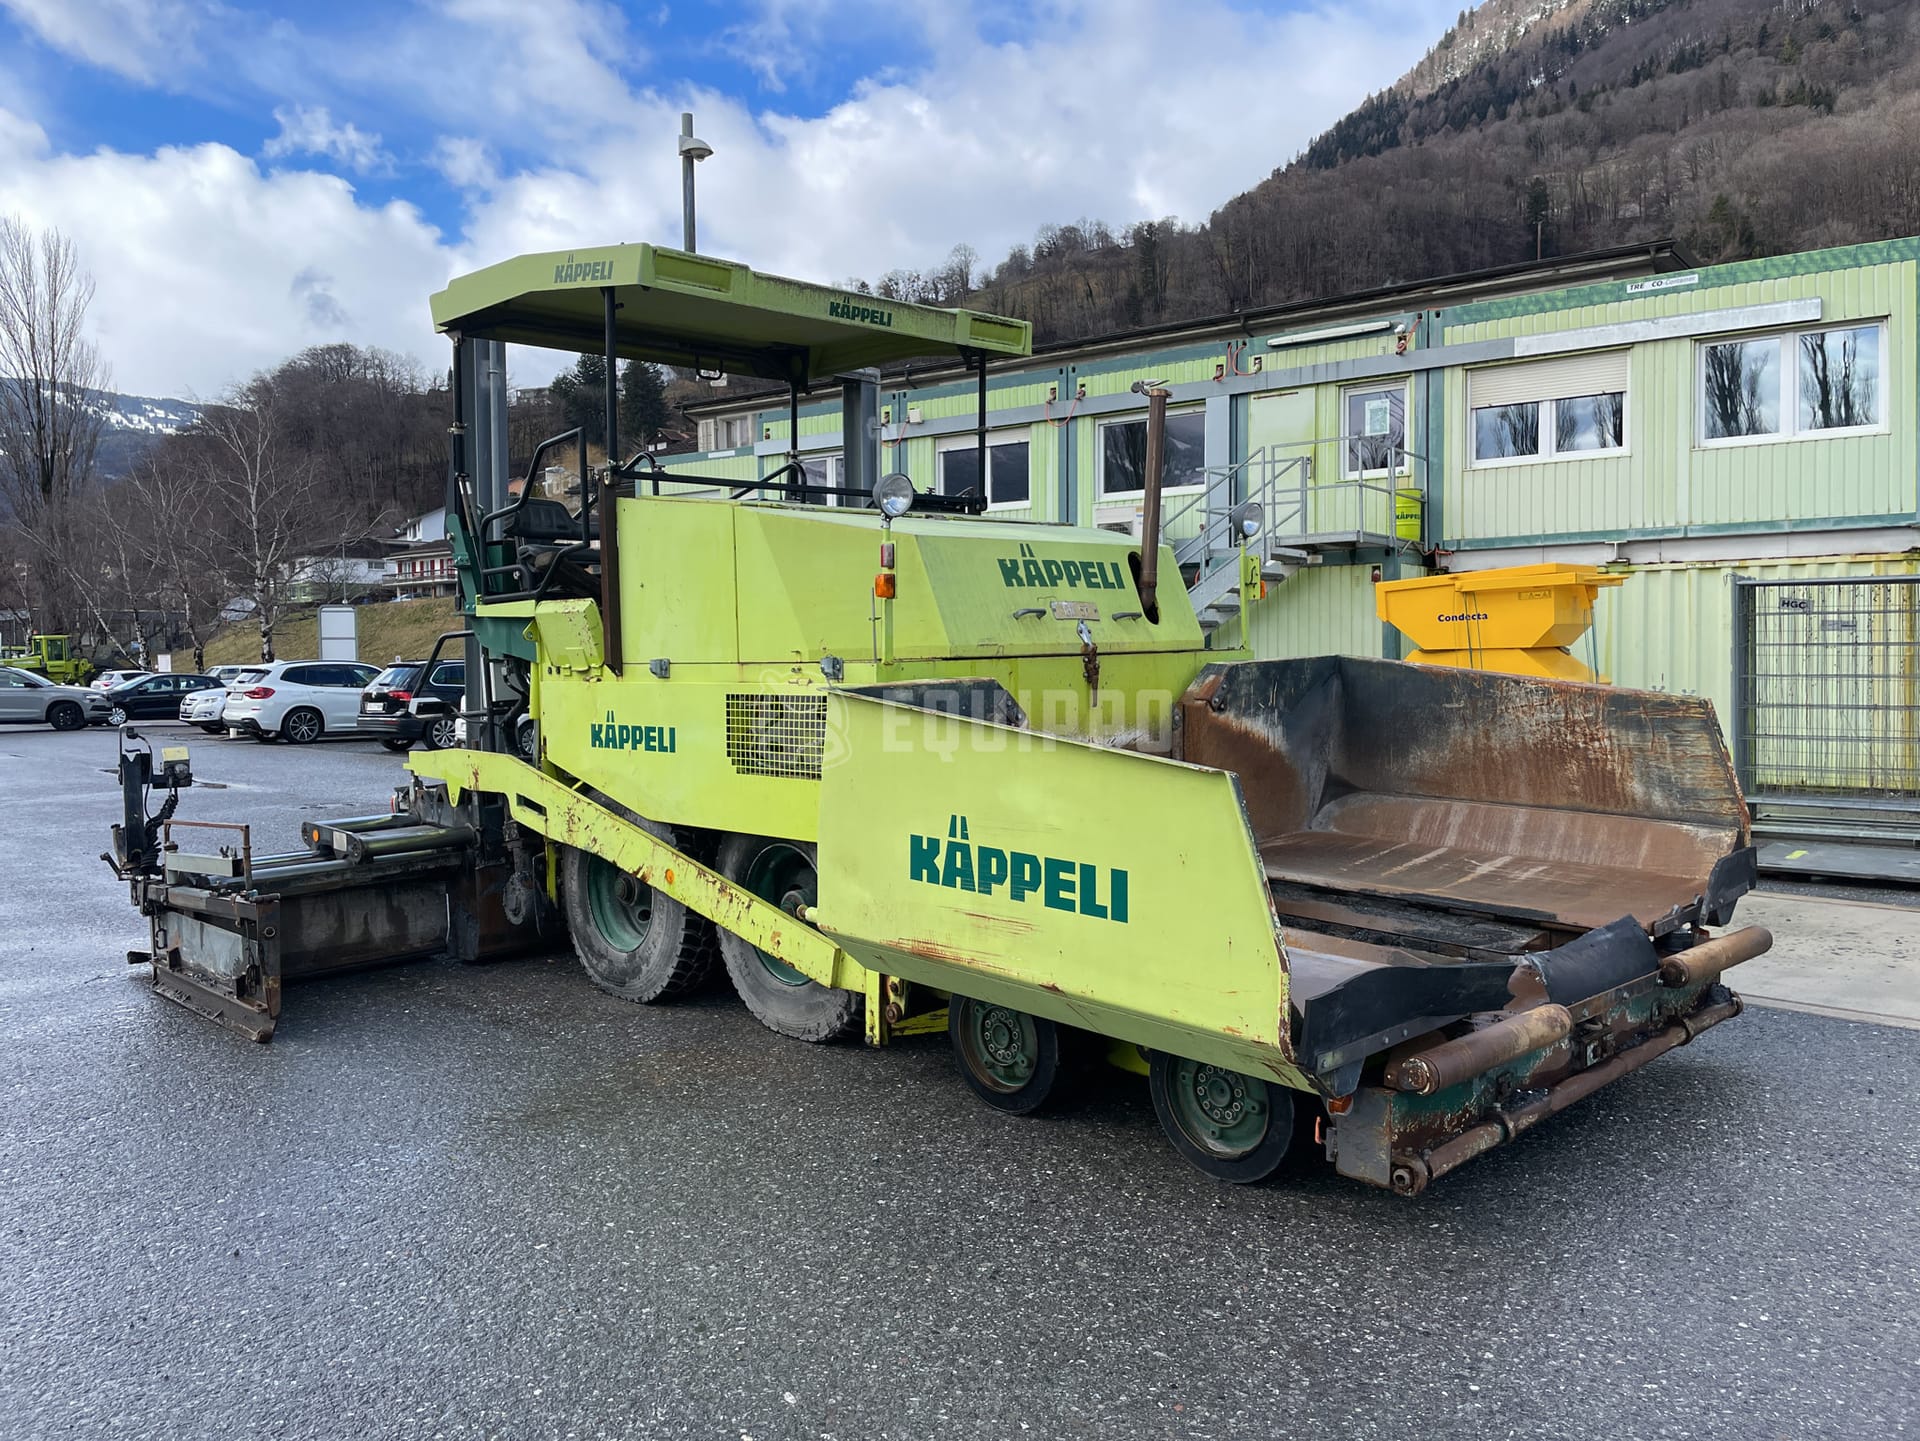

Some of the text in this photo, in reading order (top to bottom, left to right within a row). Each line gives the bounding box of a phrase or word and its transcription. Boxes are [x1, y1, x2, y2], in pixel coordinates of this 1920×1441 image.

[554, 253, 614, 283] KÄPPELI
[829, 295, 893, 327] KÄPPELI
[997, 543, 1125, 589] KÄPPELI
[1437, 612, 1488, 622] Condecta
[590, 710, 676, 753] KÄPPELI
[909, 814, 1128, 924] KÄPPELI
